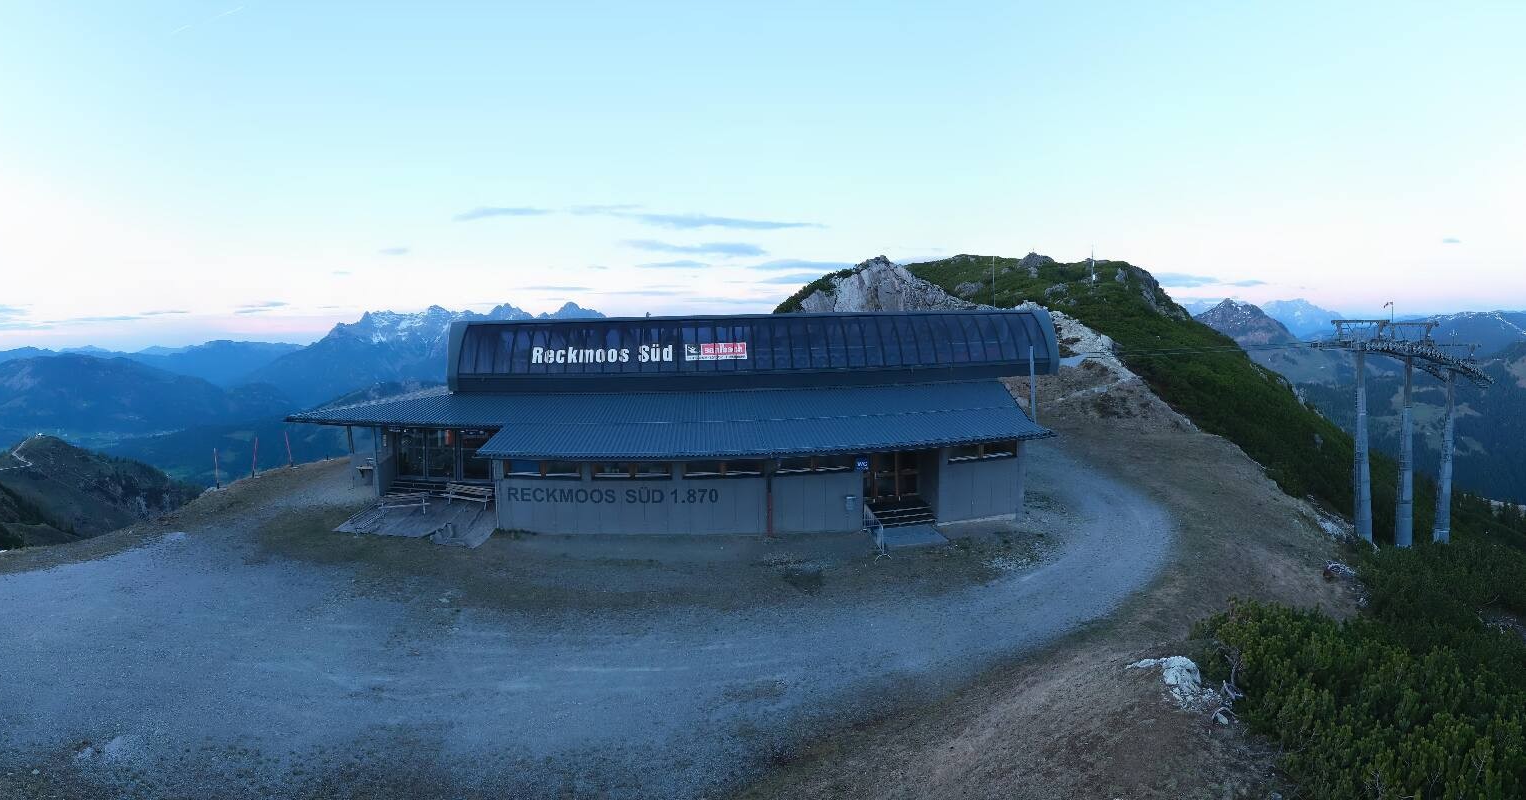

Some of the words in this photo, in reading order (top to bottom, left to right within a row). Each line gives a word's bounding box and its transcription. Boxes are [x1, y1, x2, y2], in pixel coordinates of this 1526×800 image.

[531, 346, 630, 364] Reckmoos
[638, 343, 673, 363] Süd
[507, 486, 616, 504] RECKMOOS
[625, 486, 665, 504] SÜD
[670, 488, 719, 504] 1.870
